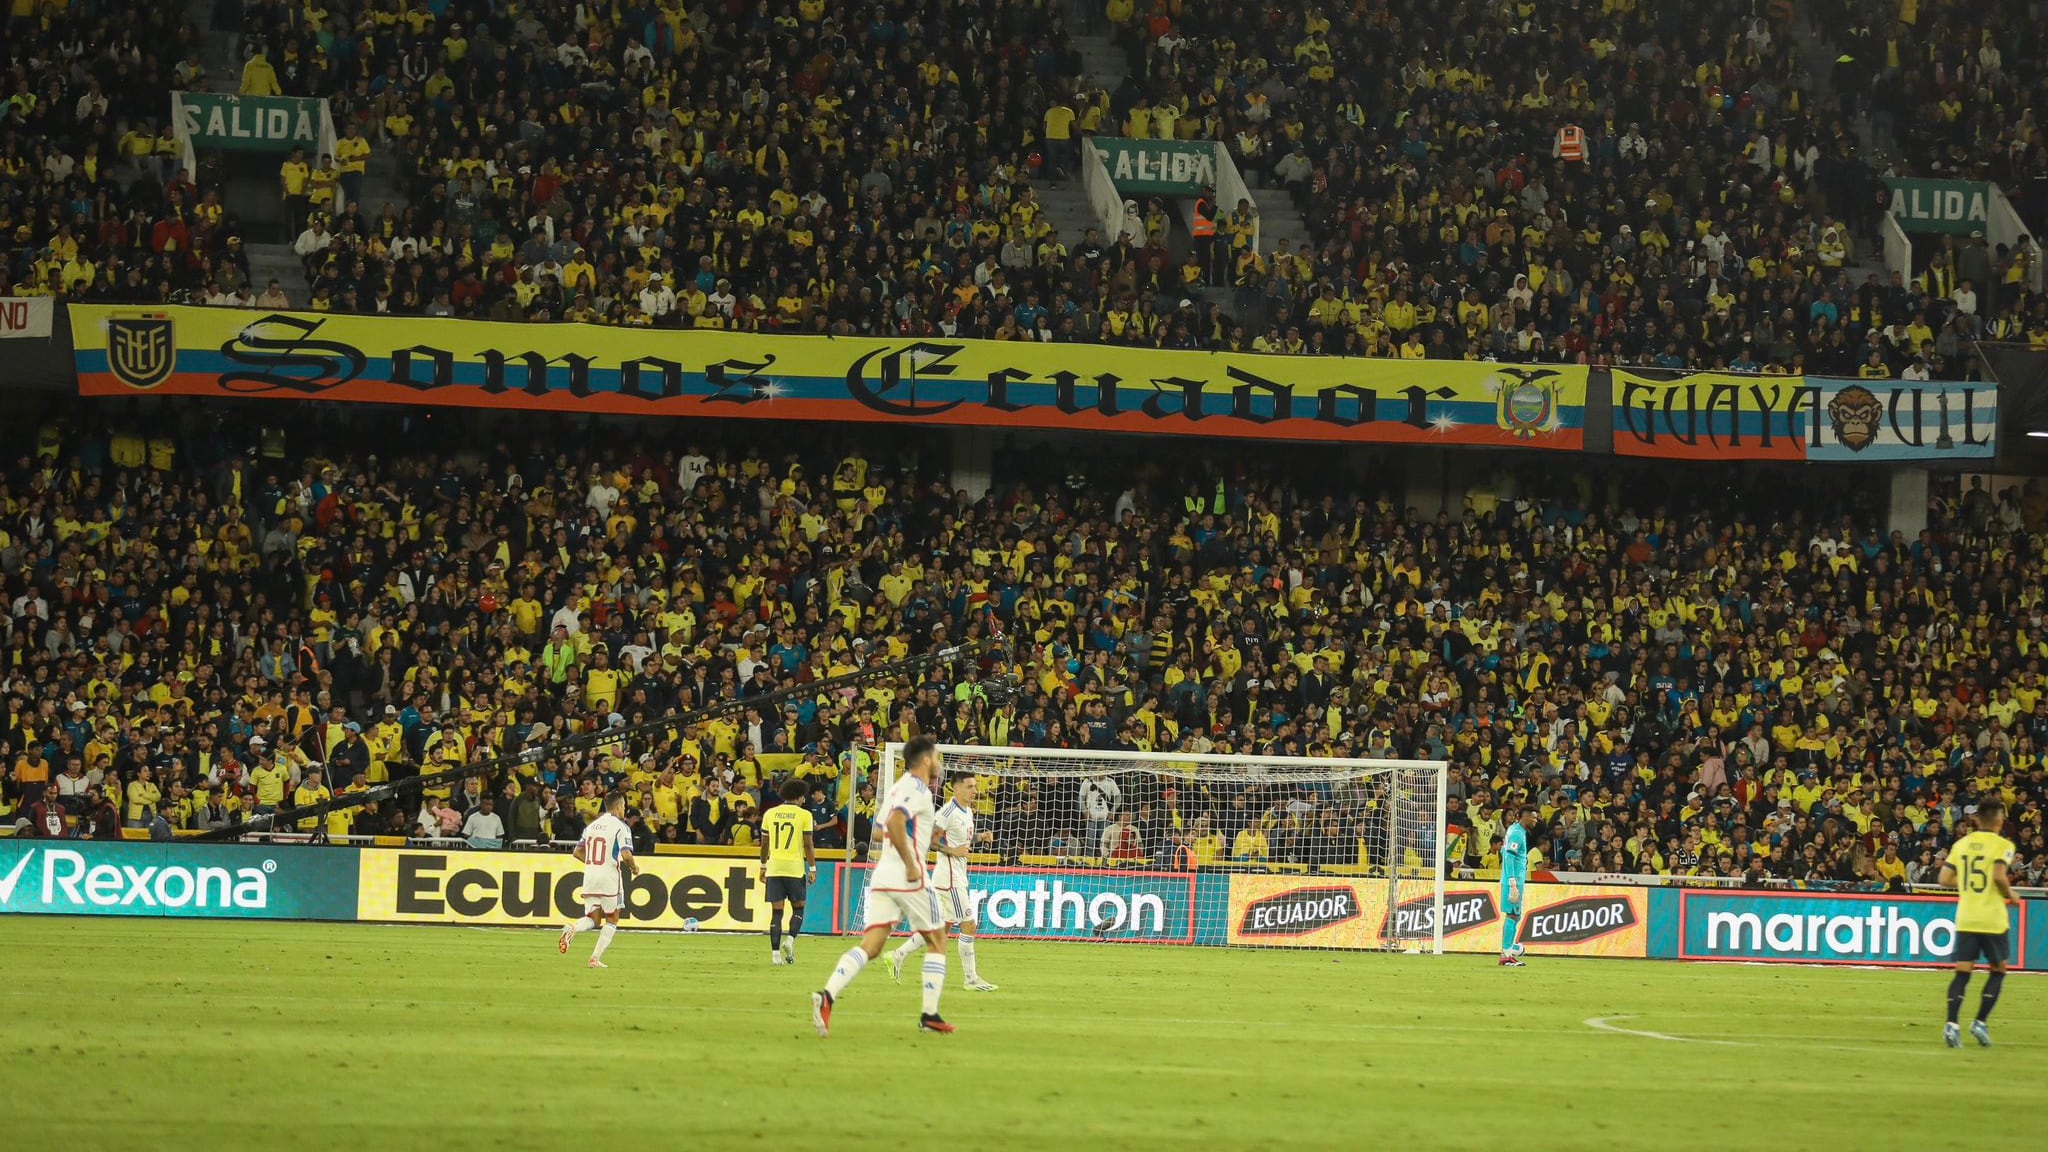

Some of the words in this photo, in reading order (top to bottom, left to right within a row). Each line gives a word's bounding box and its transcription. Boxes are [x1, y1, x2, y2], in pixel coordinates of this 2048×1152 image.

[183, 104, 314, 141] SALIDA
[1890, 188, 1987, 222] ALIDA
[586, 836, 607, 865] 10
[773, 821, 795, 850] 17
[1961, 854, 1987, 893] 15
[864, 879, 1165, 932] rathon
[1253, 894, 1348, 929] ECUADOR
[1531, 903, 1624, 938] ECUADOR
[1706, 906, 1956, 957] maratho
